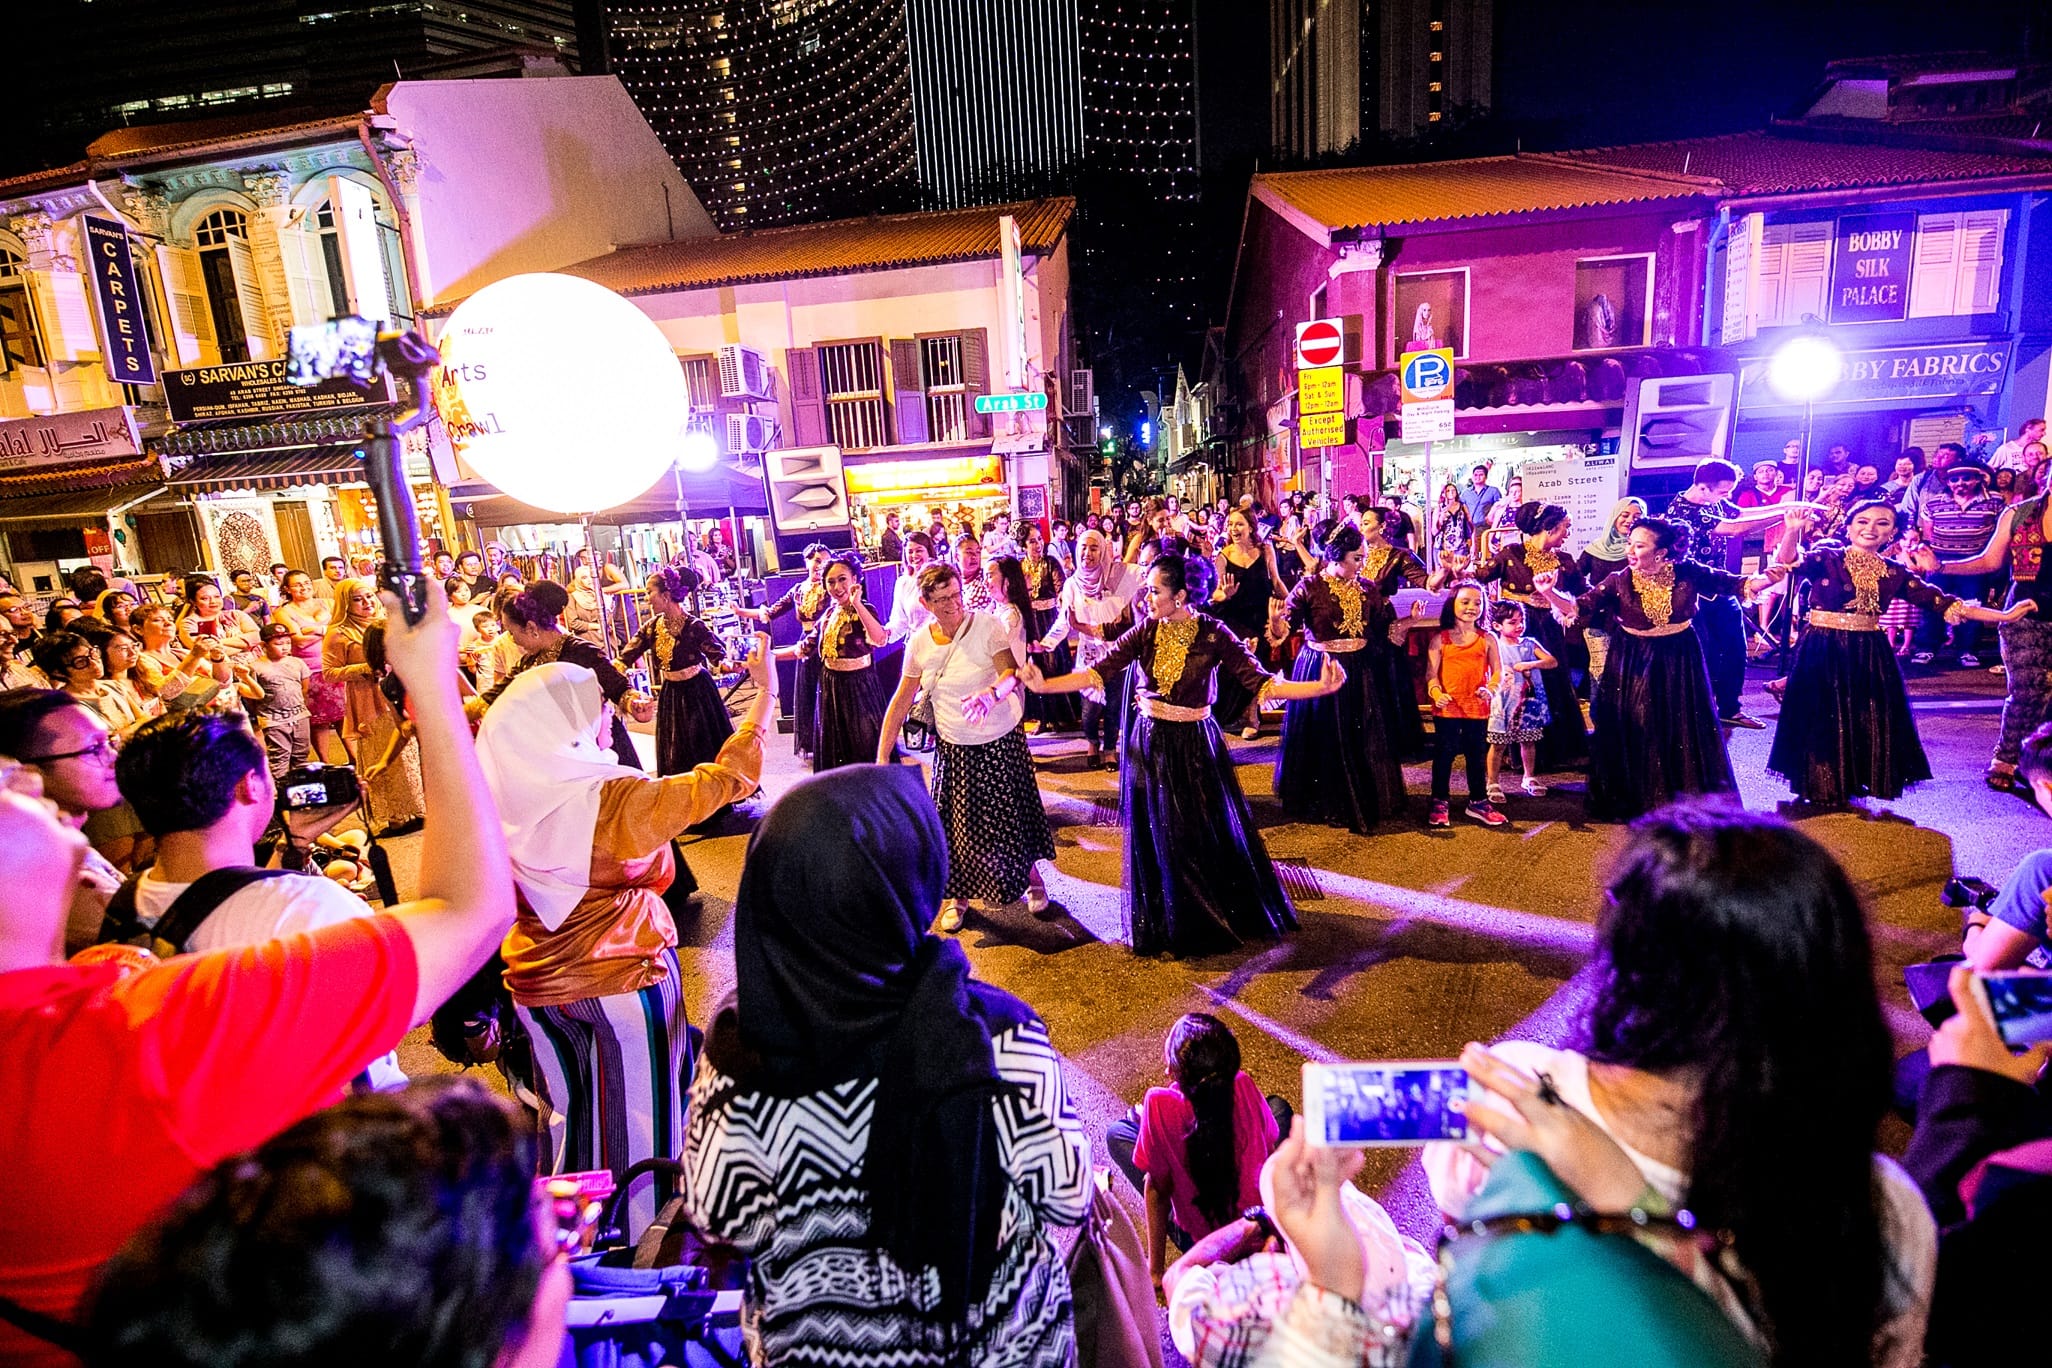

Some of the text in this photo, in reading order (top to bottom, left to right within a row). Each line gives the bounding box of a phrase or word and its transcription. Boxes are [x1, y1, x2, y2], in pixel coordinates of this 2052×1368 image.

[1848, 229, 1902, 252] BOBBY
[1855, 258, 1890, 278] SILK
[1842, 285, 1898, 306] PALACE
[103, 242, 140, 372] CARPETS
[200, 363, 269, 384] SARVAN'S
[442, 363, 487, 388] Arts
[1889, 352, 2003, 379] FABRICS
[982, 394, 1040, 410] Arab St
[1304, 392, 1315, 400] Sat
[1325, 390, 1336, 398] Sun
[447, 413, 506, 442] Crawl
[1302, 425, 1344, 436] Authorised
[1309, 415, 1335, 426] Except
[1307, 436, 1339, 446] Vehicles
[1538, 476, 1604, 488] Arab Street
[91, 544, 110, 554] OFF
